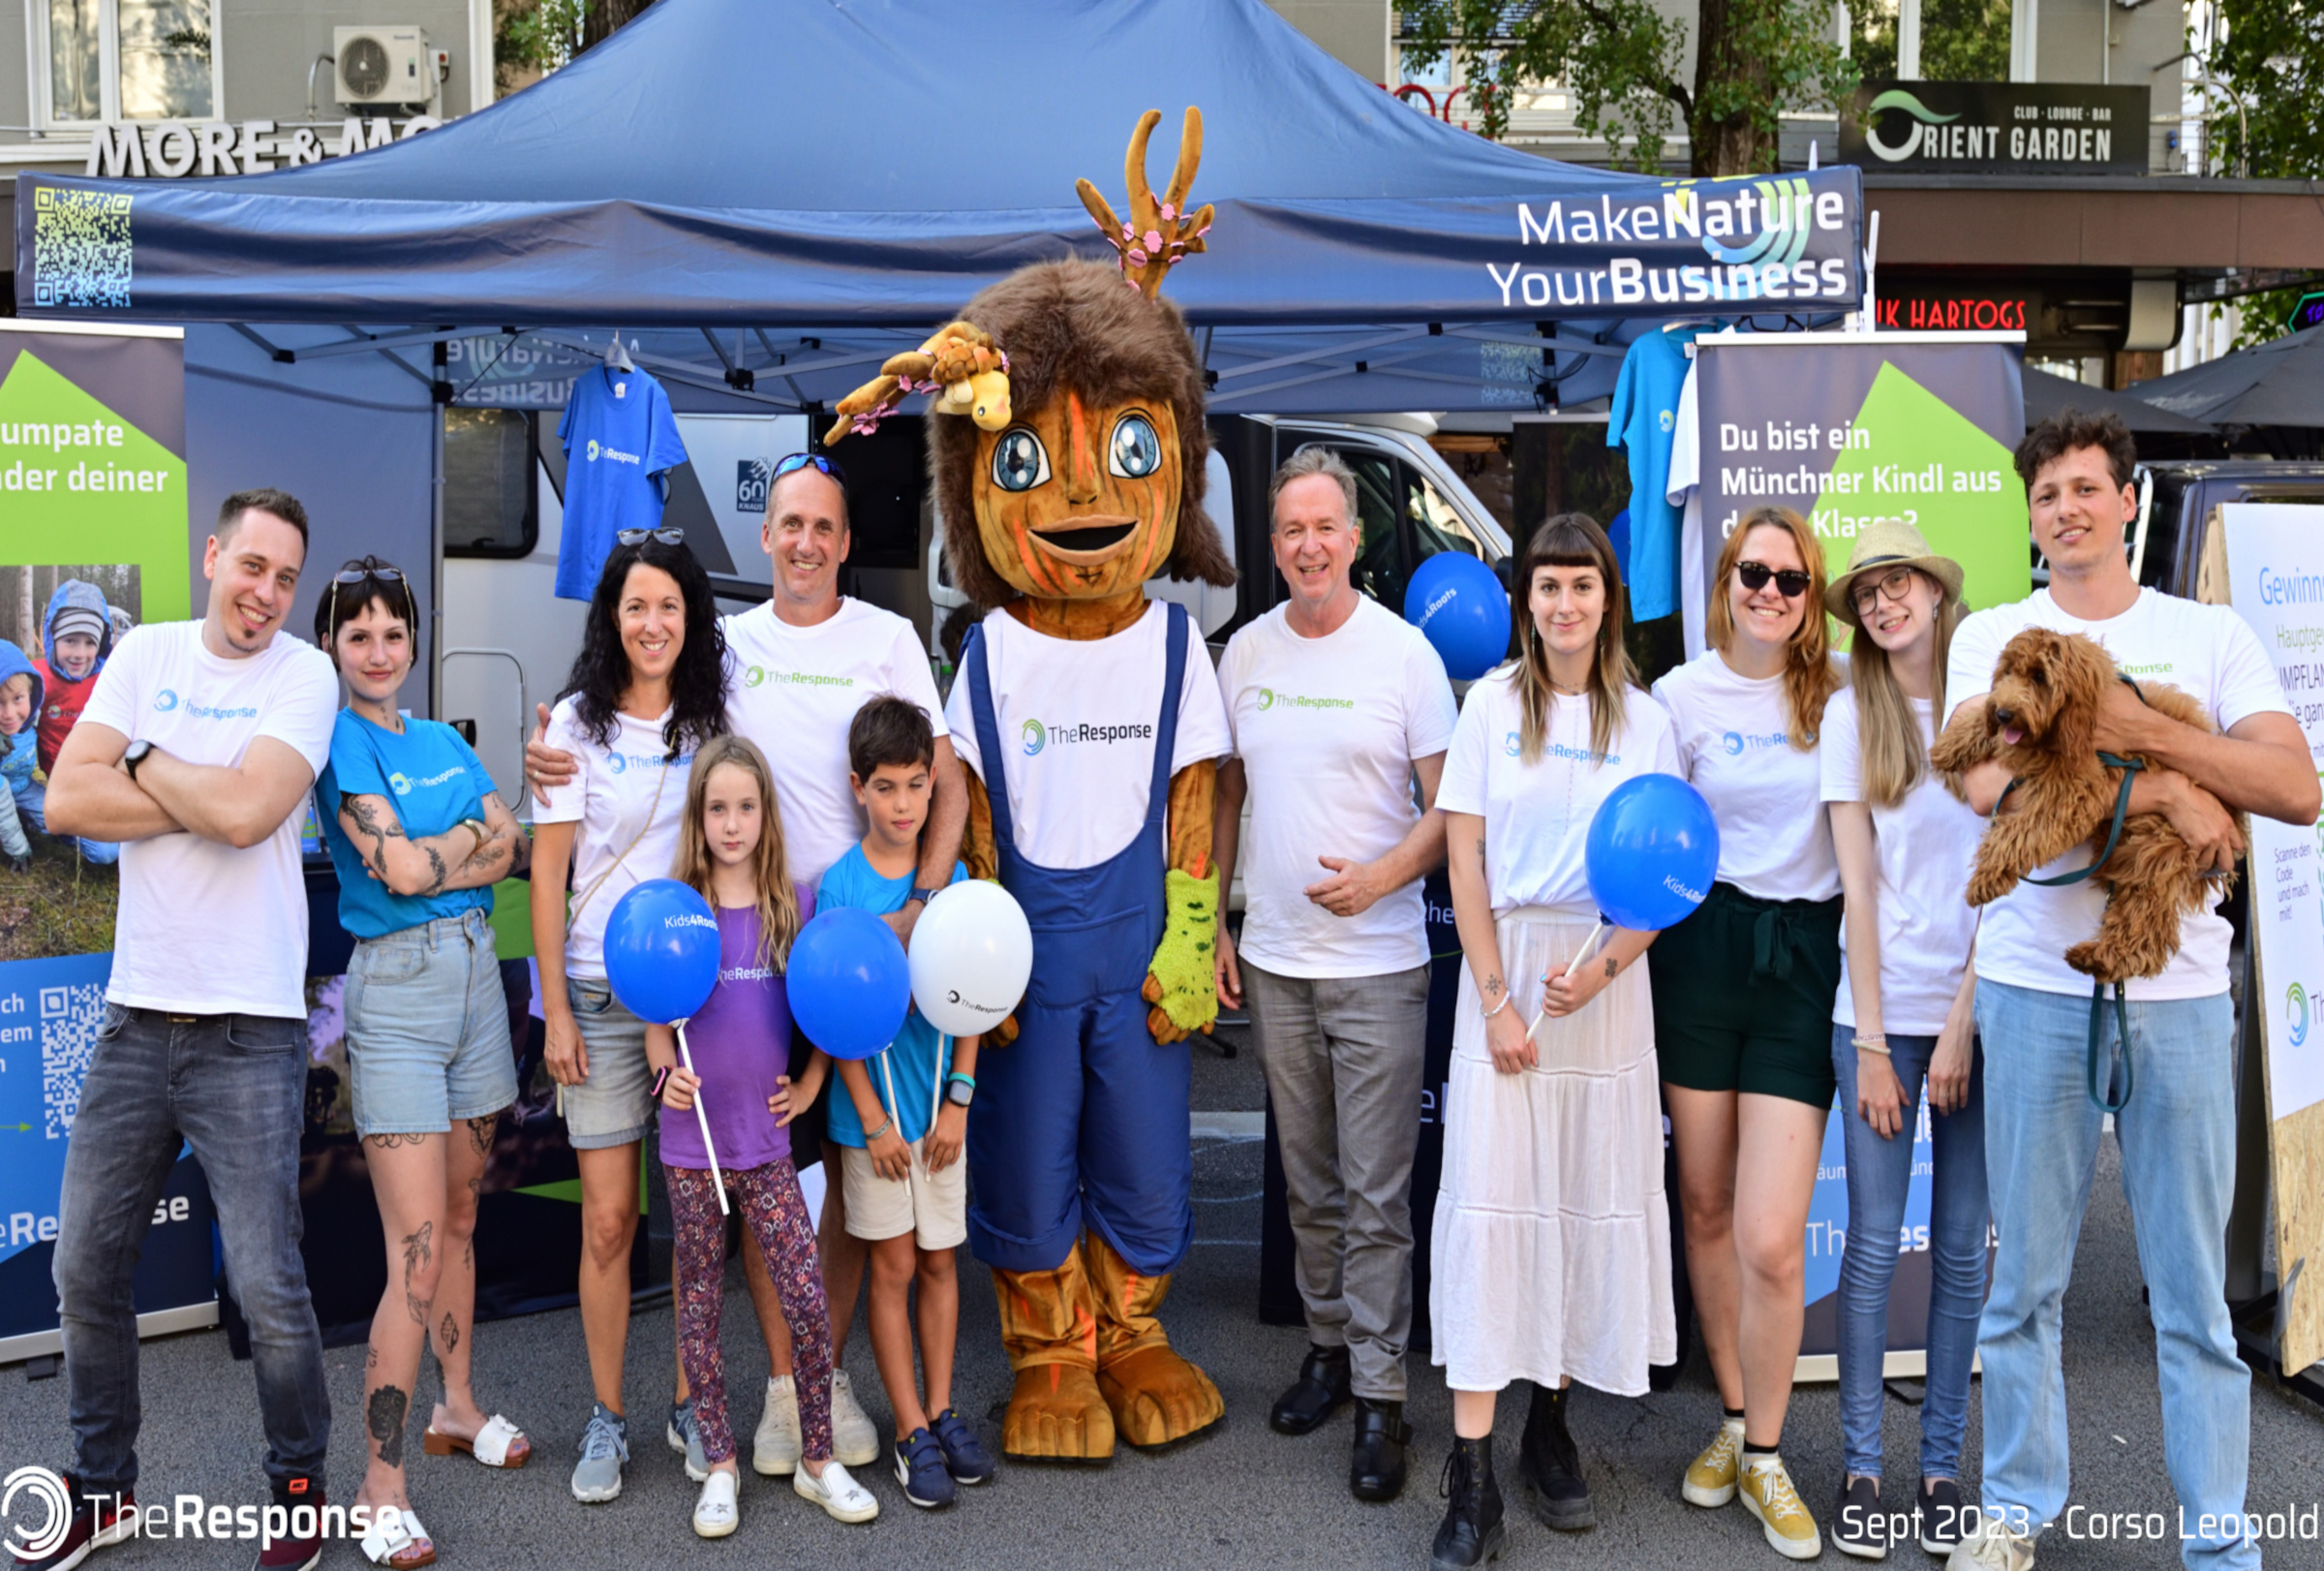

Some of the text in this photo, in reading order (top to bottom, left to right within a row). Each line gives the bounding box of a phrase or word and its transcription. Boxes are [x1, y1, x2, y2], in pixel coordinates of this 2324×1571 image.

[2013, 106, 2111, 121] CLUB LOUNGE BAR
[85, 119, 277, 178] MORE
[2009, 126, 2111, 162] GARDEN
[1517, 186, 1845, 246] MakeNature
[1485, 249, 1848, 307] YourBusiness
[1910, 298, 2026, 330] HARTOGS
[0, 418, 124, 453] umpate
[1720, 419, 1871, 451] Du bist ein
[0, 460, 168, 493] der deiner
[1721, 463, 2003, 496] Münchner Kindl aus
[737, 502, 765, 511] KNAUS
[2258, 565, 2324, 605] Gewinn
[2275, 623, 2324, 654] Hauptge
[767, 669, 854, 688] TheResponse
[1275, 693, 1355, 711] TheResponse
[2304, 702, 2324, 730] gan
[1047, 723, 1152, 746] TheResponse
[2276, 864, 2294, 883] Code
[2278, 883, 2291, 903] und
[1428, 899, 1455, 925] he
[0, 992, 25, 1014] ch
[0, 1026, 33, 1044] em
